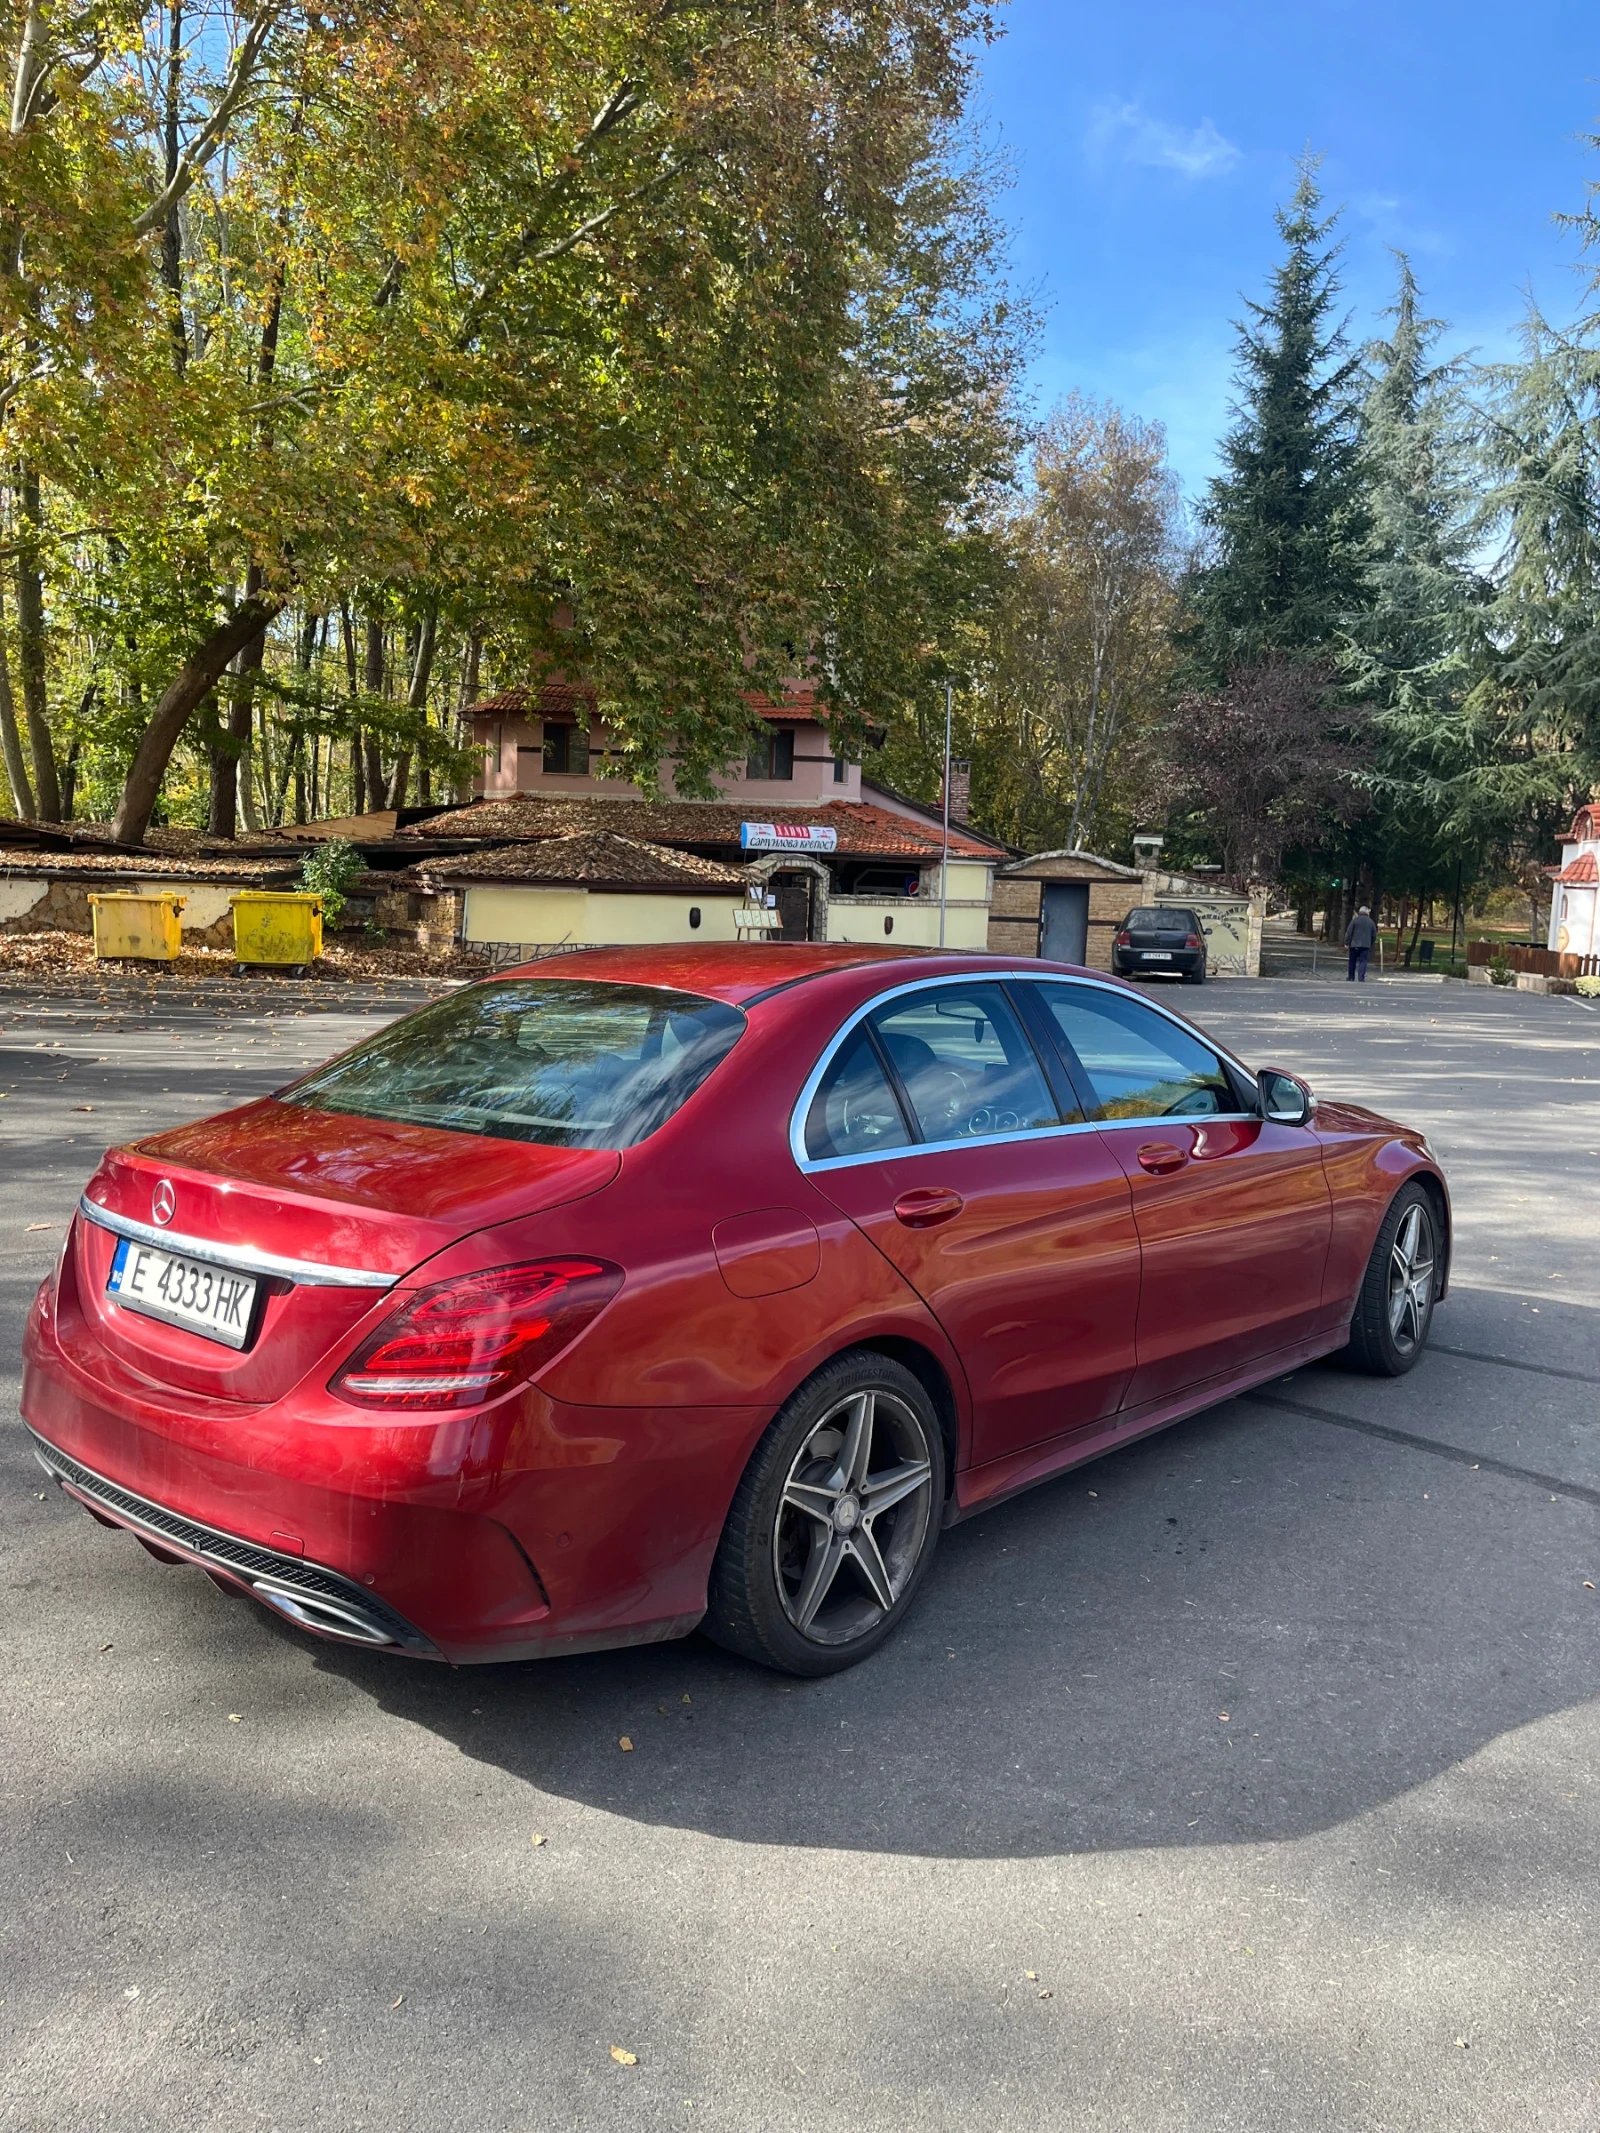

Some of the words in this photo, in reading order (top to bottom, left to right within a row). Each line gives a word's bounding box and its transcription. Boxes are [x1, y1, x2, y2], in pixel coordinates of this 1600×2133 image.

[776, 825, 809, 837] ХАНЧЕ
[112, 1270, 123, 1284] BG
[131, 1251, 151, 1292] E
[157, 1259, 213, 1313] 4333
[213, 1276, 250, 1327] HK
